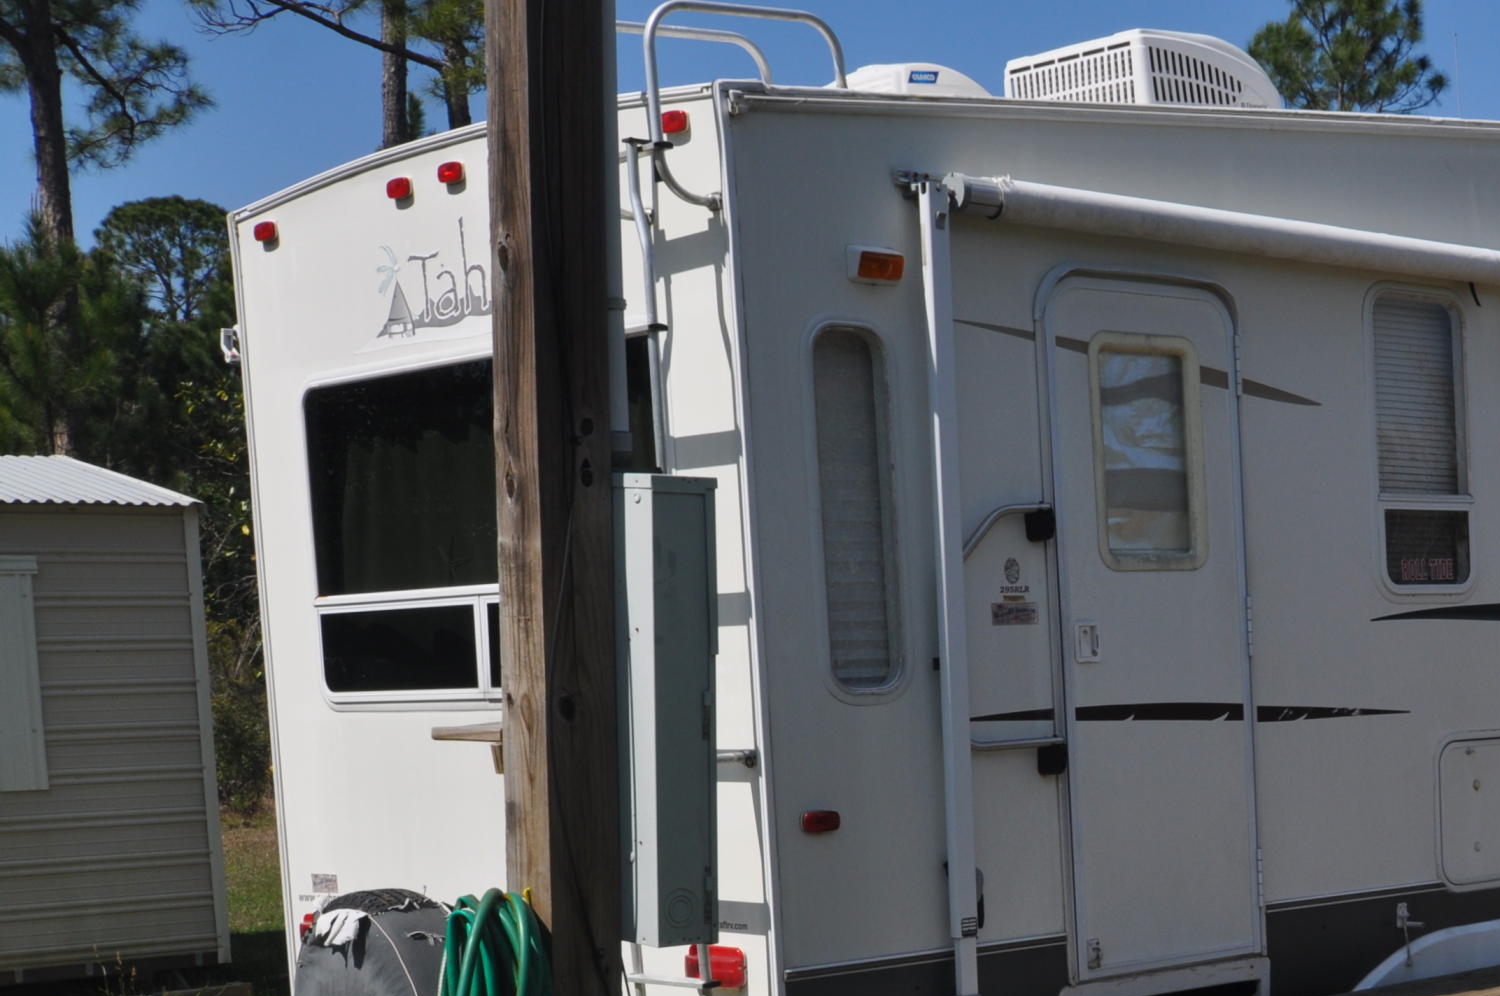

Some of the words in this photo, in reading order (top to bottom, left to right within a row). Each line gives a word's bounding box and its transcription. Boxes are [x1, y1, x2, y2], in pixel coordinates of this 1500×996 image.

[408, 215, 489, 321] Tah
[1401, 558, 1428, 579] ROLL
[1429, 558, 1455, 579] TIDE
